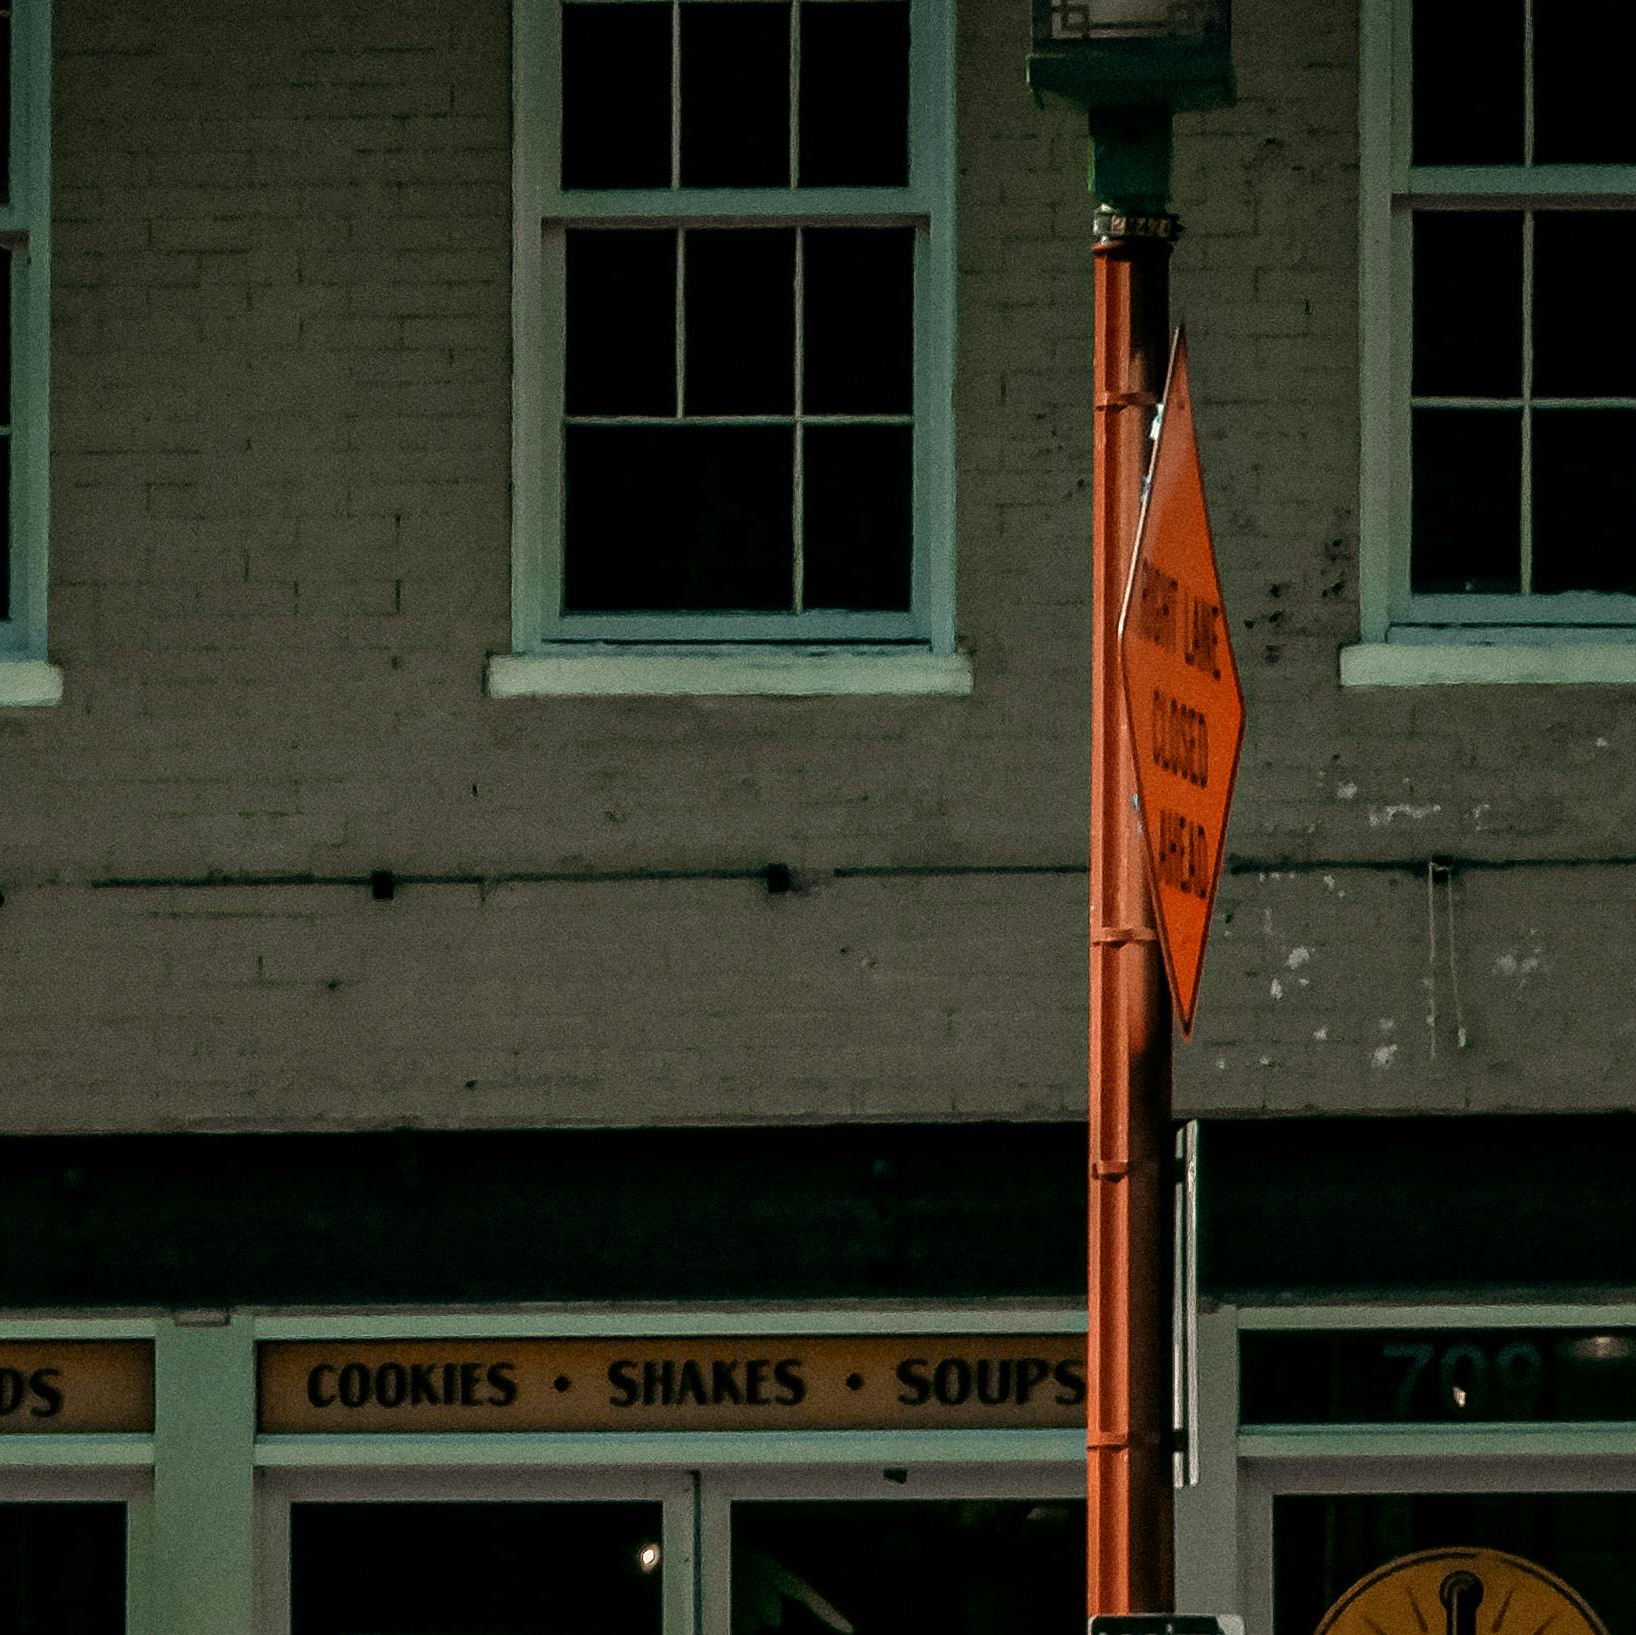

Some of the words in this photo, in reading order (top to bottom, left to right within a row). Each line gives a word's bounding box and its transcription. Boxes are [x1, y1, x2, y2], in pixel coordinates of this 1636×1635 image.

[307, 1360, 517, 1408] COOKIES
[608, 1357, 806, 1407] SHAKES
[897, 1355, 1087, 1406] SOUPS
[1381, 1340, 1545, 1418] 709
